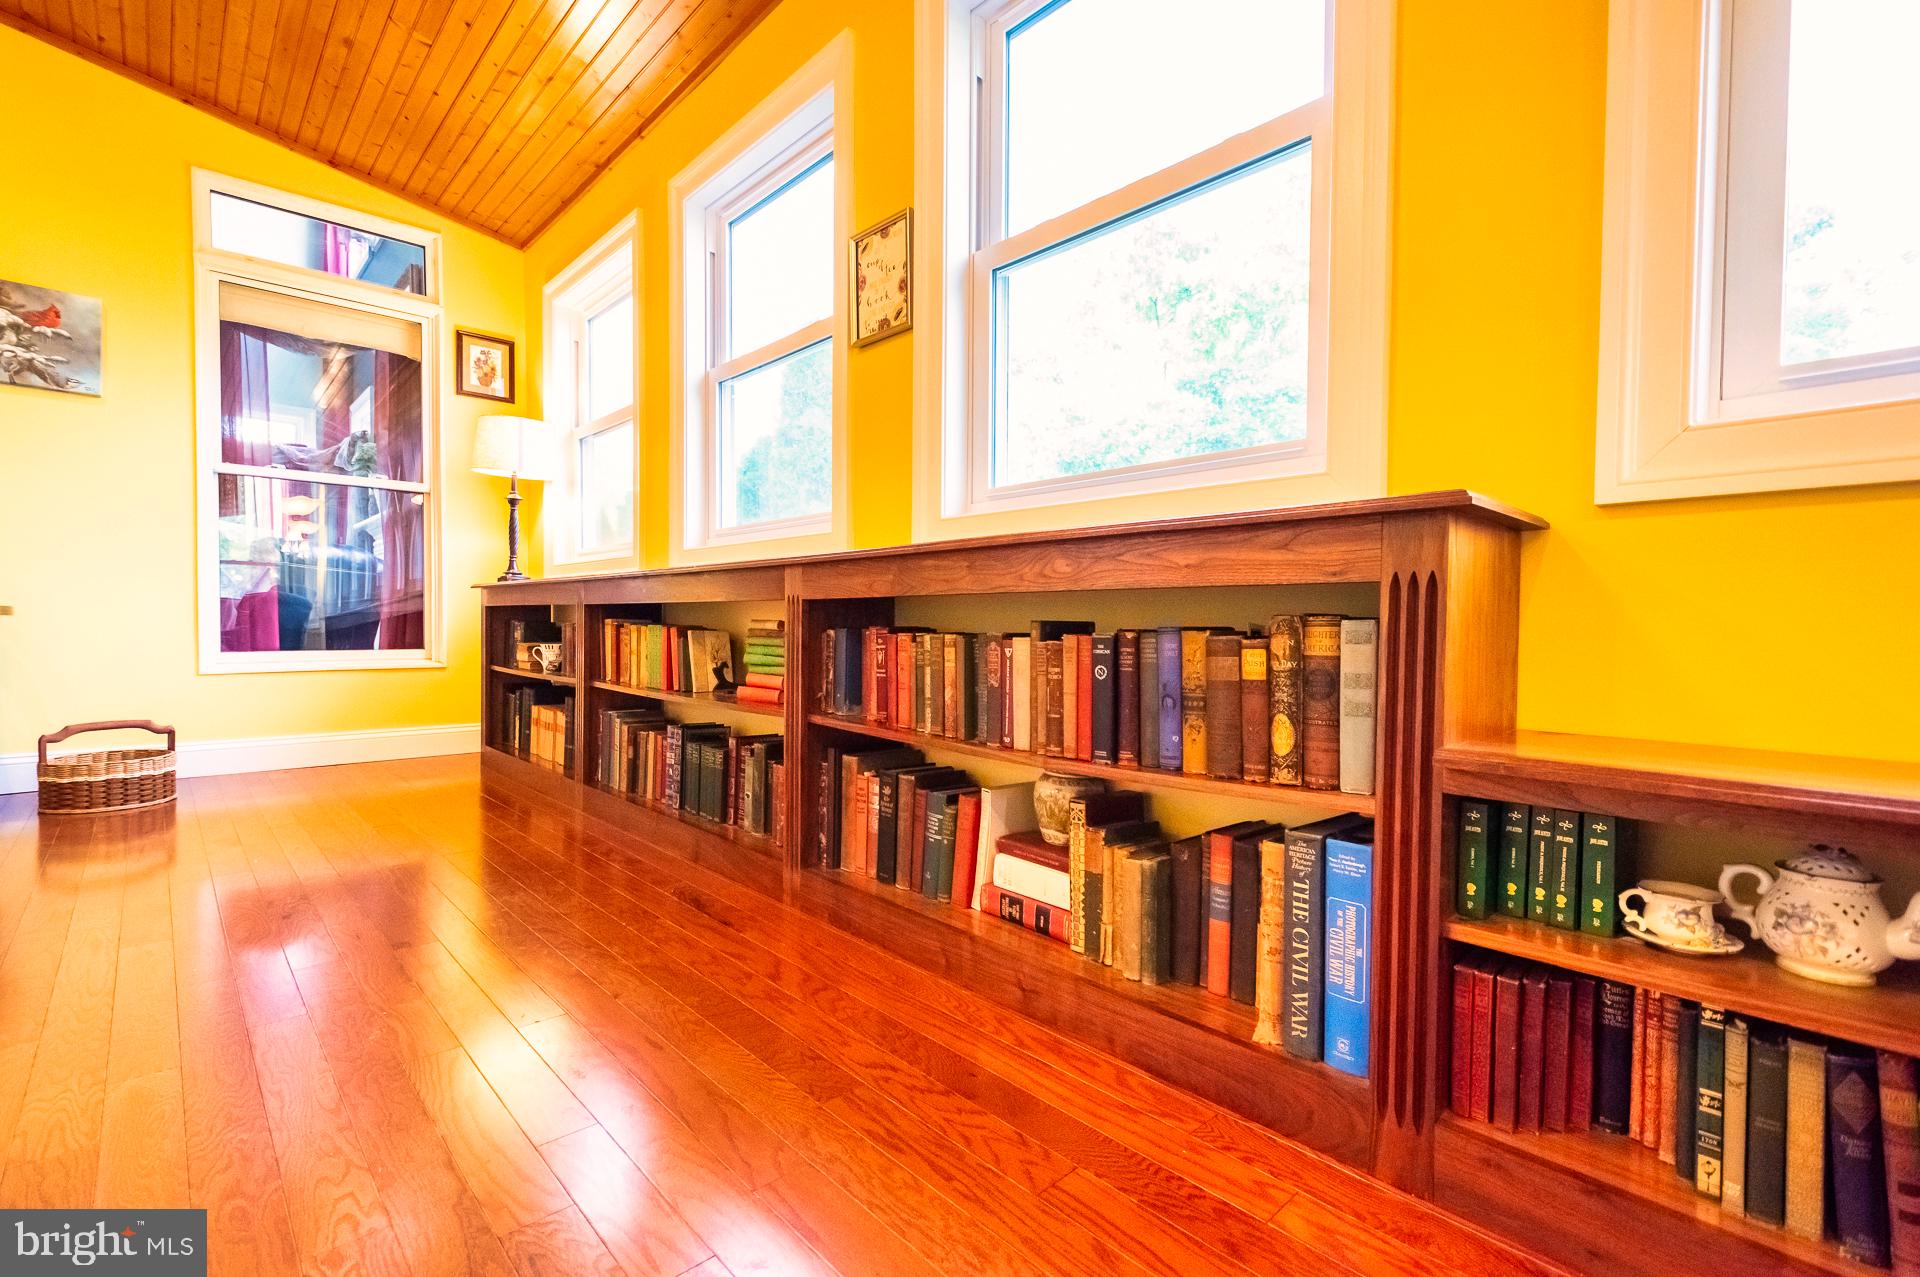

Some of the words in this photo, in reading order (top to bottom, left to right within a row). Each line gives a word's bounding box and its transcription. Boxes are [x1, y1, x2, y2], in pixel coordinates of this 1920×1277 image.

[1288, 845, 1316, 855] AMERICAN
[1288, 850, 1316, 860] HERITAGE
[1291, 862, 1313, 872] History
[1292, 880, 1310, 923] THE
[1329, 927, 1344, 957] CIVIL
[1344, 904, 1356, 964] PHOTOGRAPHIC
[1292, 927, 1310, 987] CIVIL
[1328, 958, 1344, 985] WAR
[1344, 963, 1356, 996] HISTORY
[1291, 992, 1309, 1038] WAR
